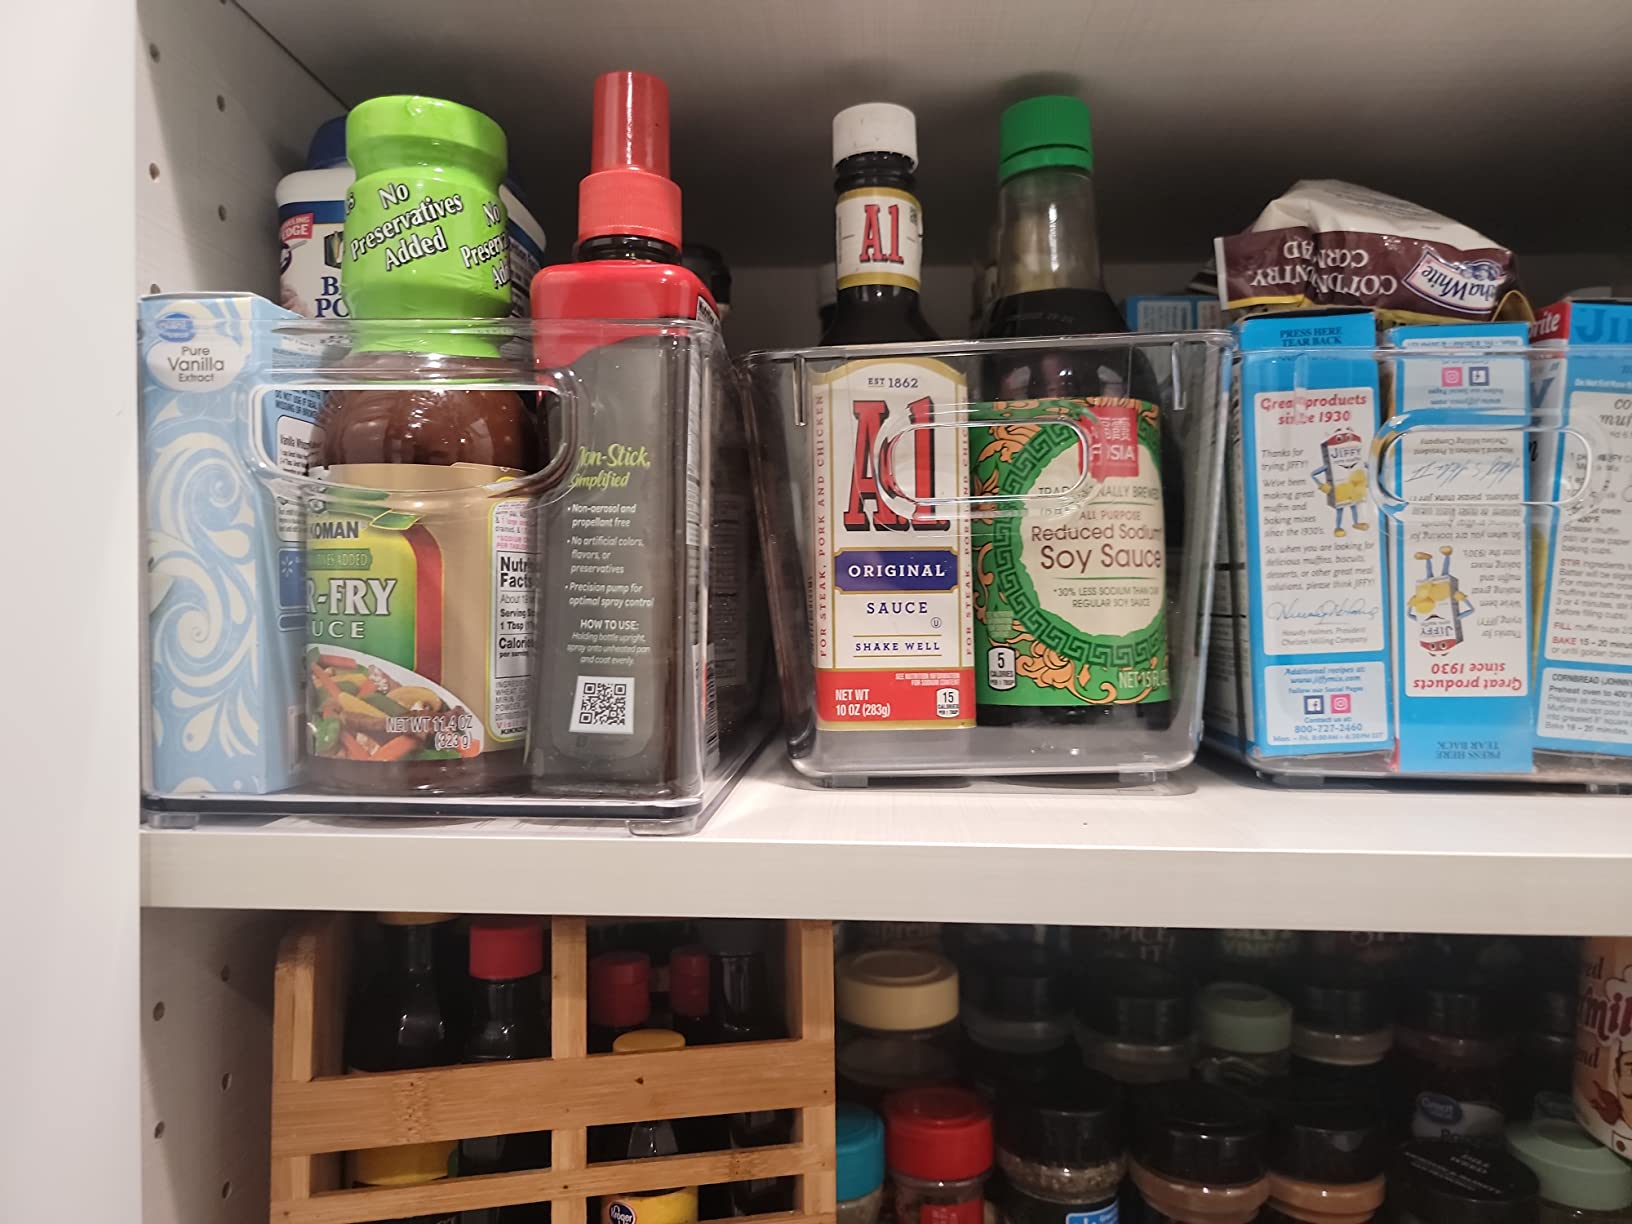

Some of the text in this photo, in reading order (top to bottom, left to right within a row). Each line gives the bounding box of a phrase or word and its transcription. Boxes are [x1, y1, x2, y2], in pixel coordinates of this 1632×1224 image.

[377, 182, 410, 211] No
[482, 200, 501, 228] No
[350, 194, 464, 262] Preservatives
[385, 226, 449, 272] Added
[1280, 326, 1342, 338] PRESS HERE
[1282, 336, 1342, 347] TEAR BACK
[181, 346, 210, 357] Pure
[167, 356, 225, 372] Vanilla
[178, 373, 215, 383] Extract
[867, 377, 919, 389] EST 1862
[1305, 394, 1368, 410] products
[1319, 410, 1351, 423] 1930
[1330, 447, 1362, 459] JIFFY
[572, 503, 637, 514] Non-aerosol and
[1079, 510, 1142, 521] ALL PURPOSE
[572, 516, 631, 529] propellant free
[815, 393, 828, 657] FOR STEAK, PORK AND CHICKEN
[1031, 524, 1115, 542] Reduced
[571, 536, 582, 545] No
[583, 535, 618, 546] artificial
[601, 551, 611, 560] or
[1040, 543, 1162, 574] Soy Sauce
[570, 563, 625, 575] preservatives
[848, 564, 946, 578] ORIGINAL
[569, 582, 643, 595] Precision pump for
[1079, 586, 1098, 596] LESS
[1099, 586, 1131, 596] SODIUM
[569, 596, 655, 609] optimal spray control
[866, 601, 929, 614] SAUCE
[1072, 598, 1151, 609] REGULAR SOY SAUCE
[580, 619, 640, 630] HOW TO USE:
[855, 642, 940, 652] SHAKE WELL
[964, 626, 973, 656] FOR
[997, 652, 1005, 669] 5
[1431, 662, 1506, 676] since 1930
[1413, 676, 1522, 692] Great products
[835, 689, 870, 701] NET WT
[943, 691, 955, 704] 15
[835, 703, 891, 718] 10 OZ (283g)
[386, 716, 409, 734] NET
[410, 715, 431, 733] WT
[459, 713, 473, 731] OZ
[1469, 740, 1500, 750] TEAR
